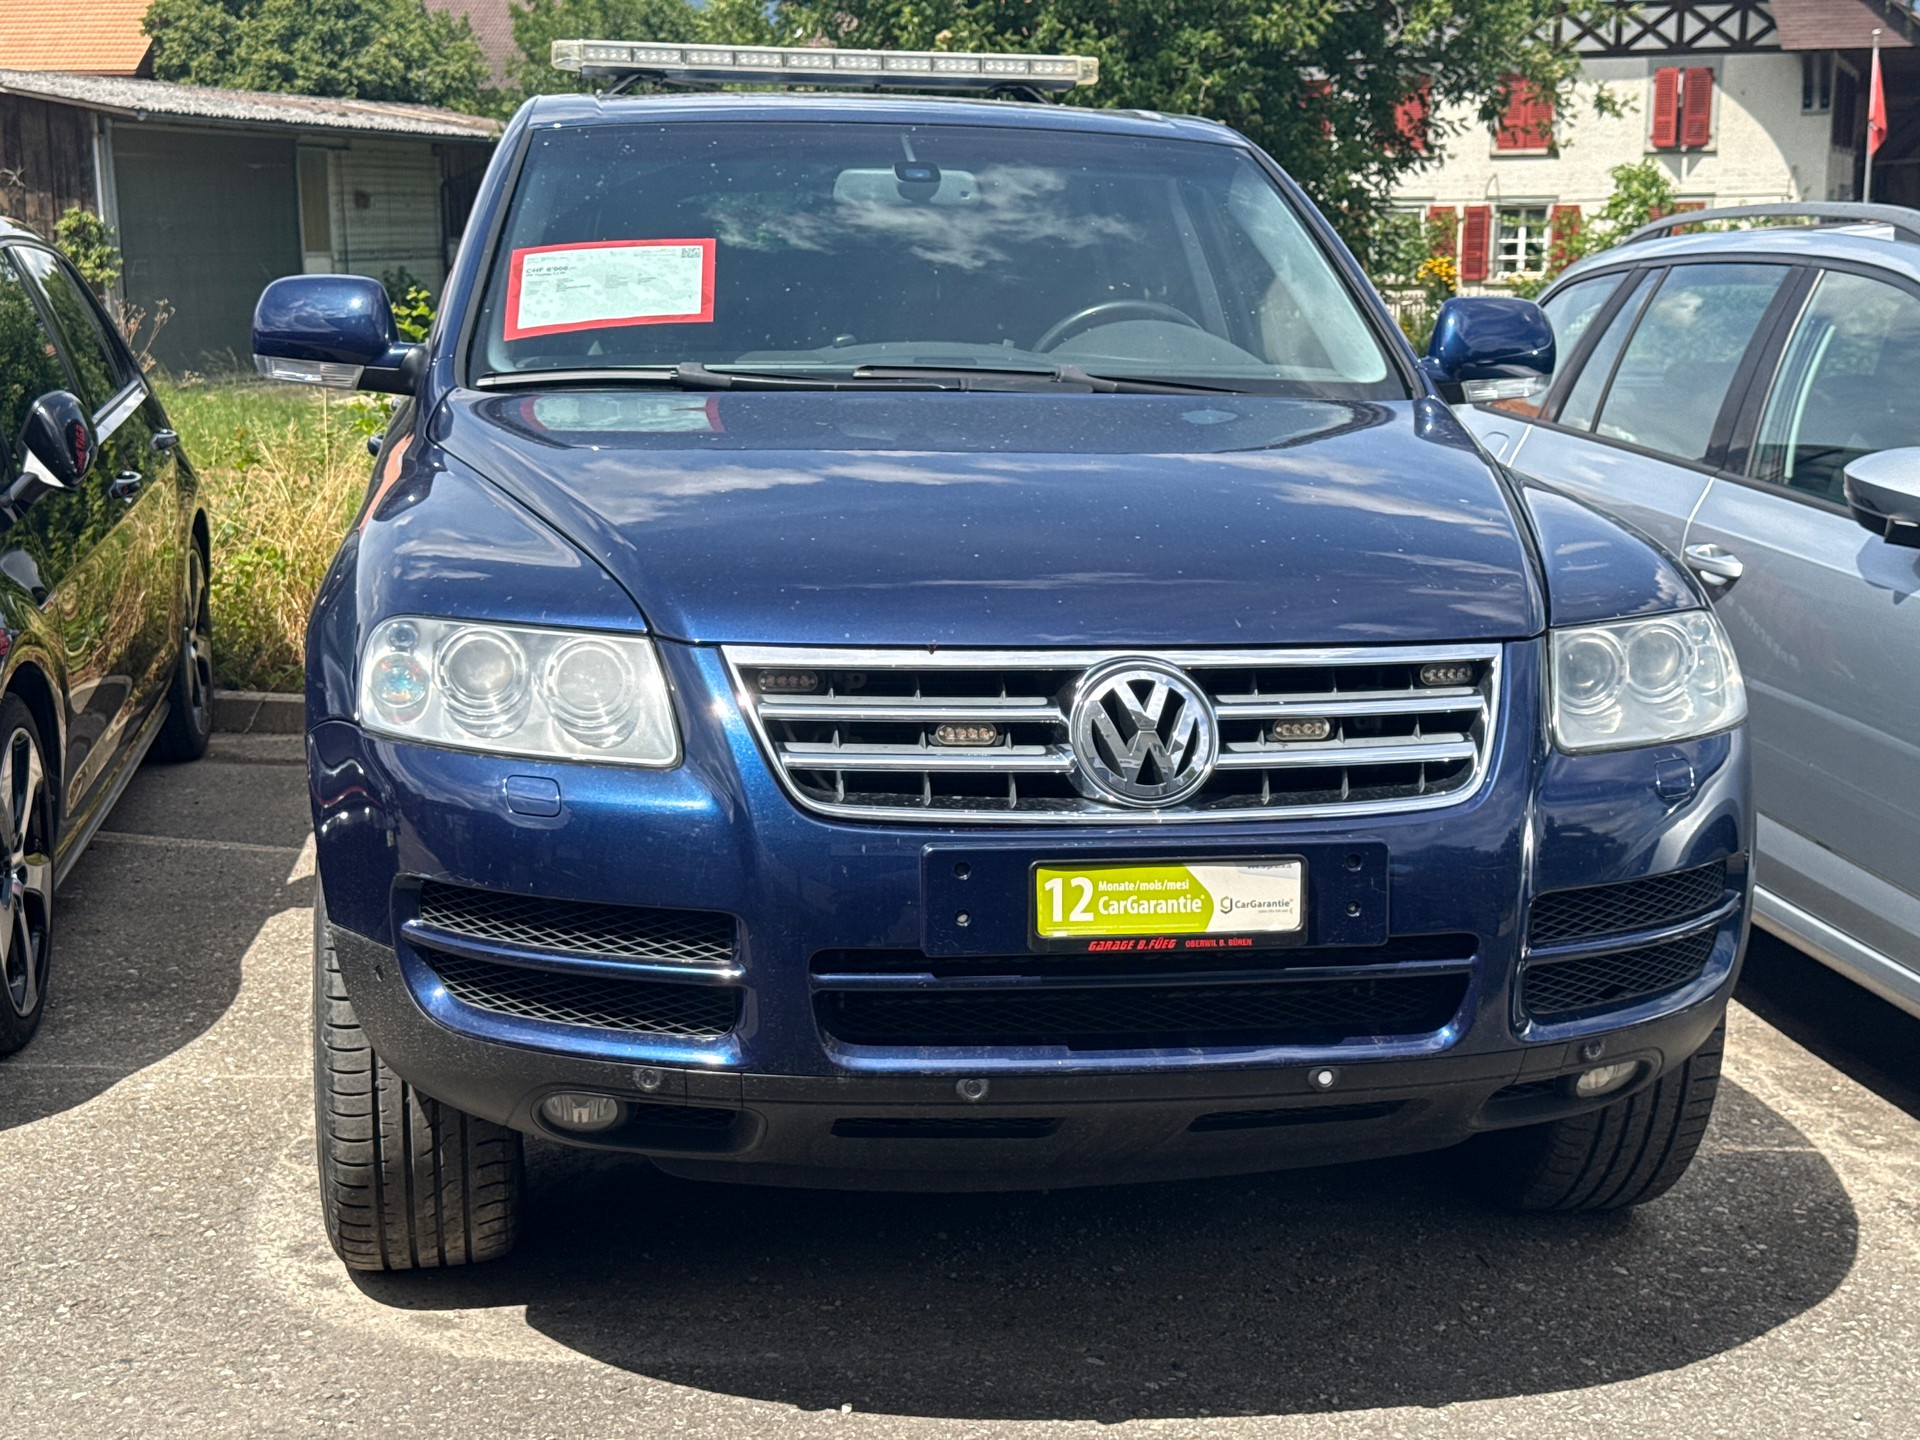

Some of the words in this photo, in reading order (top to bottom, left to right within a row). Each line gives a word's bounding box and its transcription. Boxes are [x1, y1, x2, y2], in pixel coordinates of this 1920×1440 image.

[526, 266, 544, 274] CHF
[1080, 669, 1210, 797] VW
[1044, 876, 1094, 923] 12
[1098, 894, 1203, 915] CarGarantie
[1234, 898, 1291, 909] CarGarantie
[1088, 940, 1135, 951] GARAGE
[1185, 940, 1217, 949] OBERWIL
[1228, 937, 1253, 948] BÜREN
